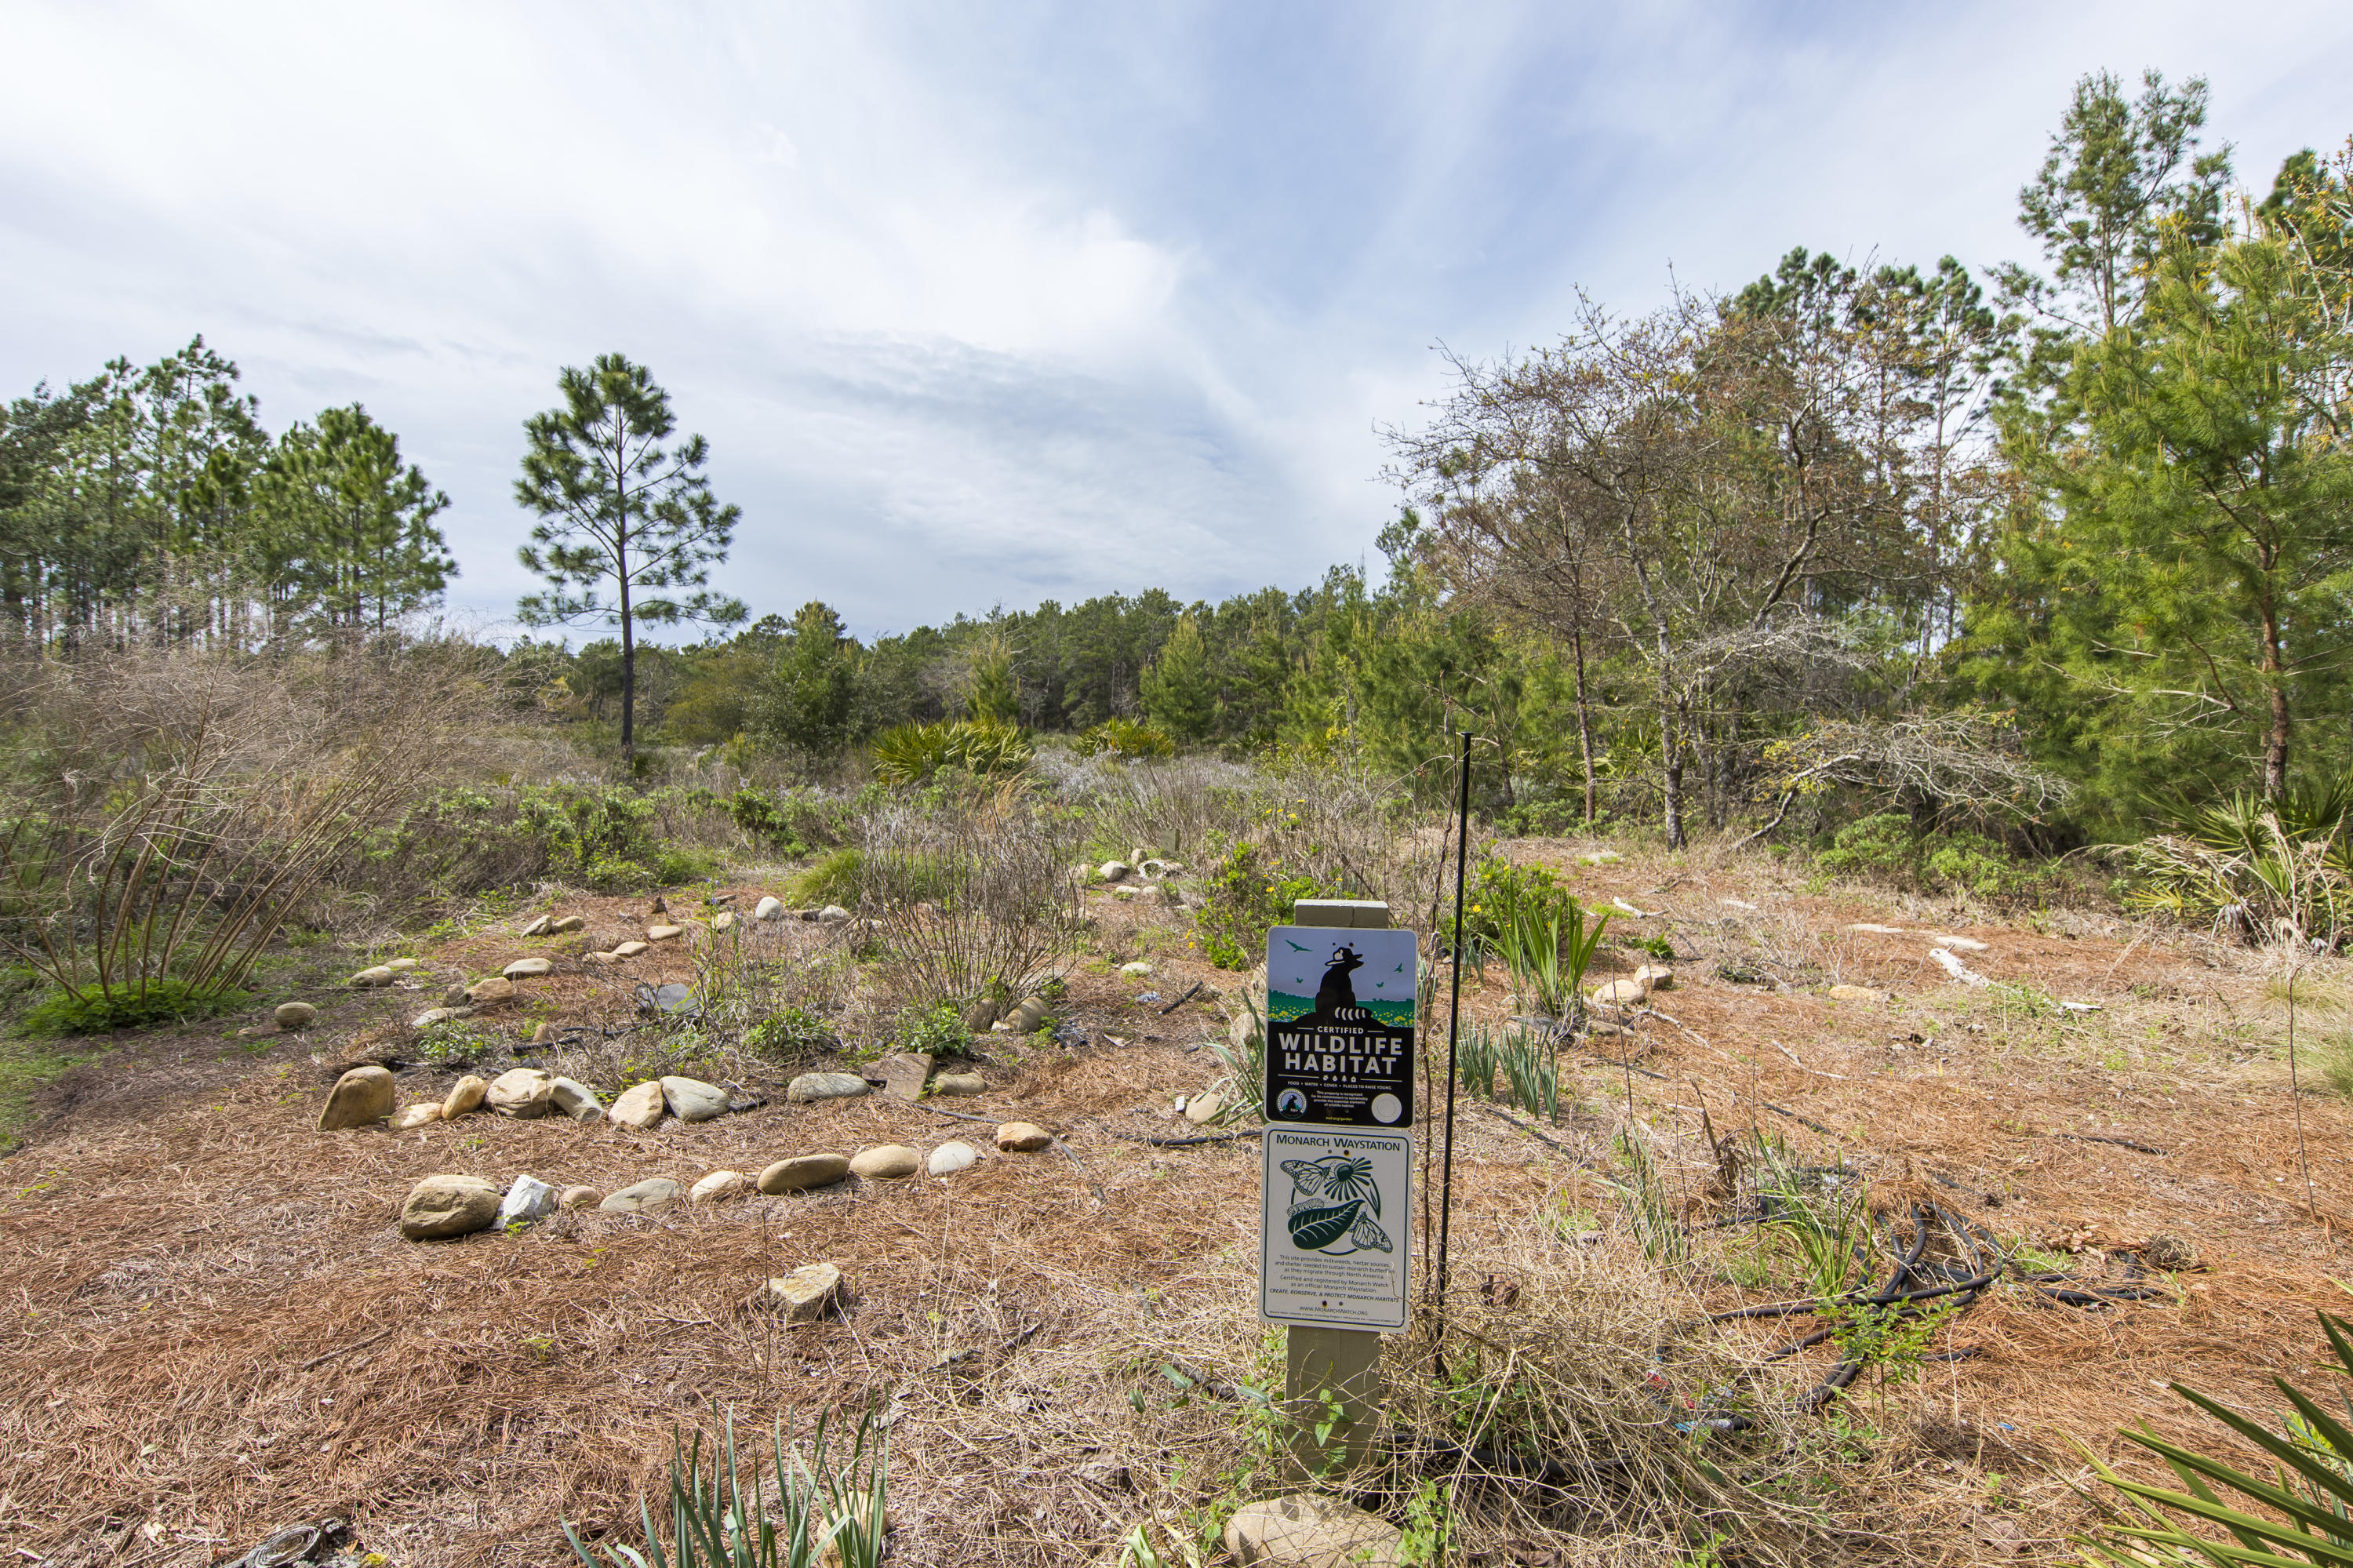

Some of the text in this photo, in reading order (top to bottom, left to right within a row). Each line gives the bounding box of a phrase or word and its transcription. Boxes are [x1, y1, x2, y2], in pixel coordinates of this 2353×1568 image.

[1317, 1026, 1364, 1034] CERTIFIED
[1278, 1033, 1402, 1055] WILDLIFE
[1285, 1052, 1397, 1075] HABITAT
